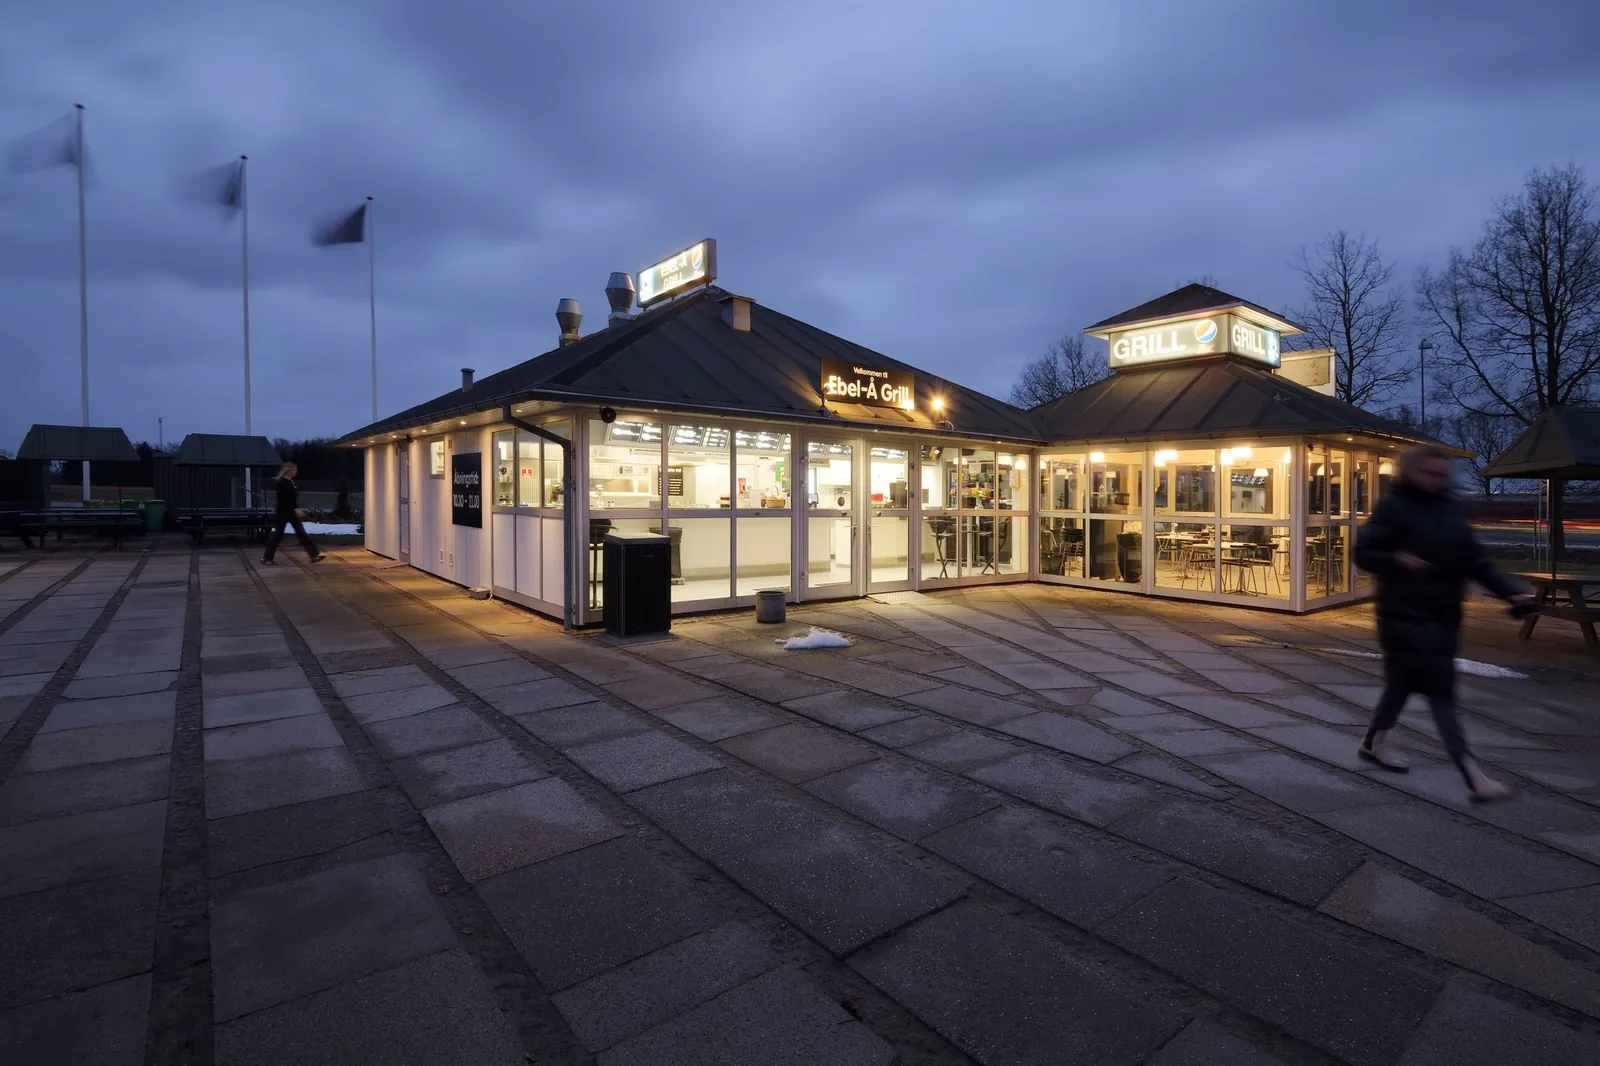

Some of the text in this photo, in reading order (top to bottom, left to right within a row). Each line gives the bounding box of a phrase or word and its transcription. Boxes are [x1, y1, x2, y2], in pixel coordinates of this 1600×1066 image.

[1113, 331, 1187, 360] GRILL
[1232, 323, 1266, 354] GRILL
[853, 366, 882, 378] Velkommen
[881, 383, 909, 405] Grill
